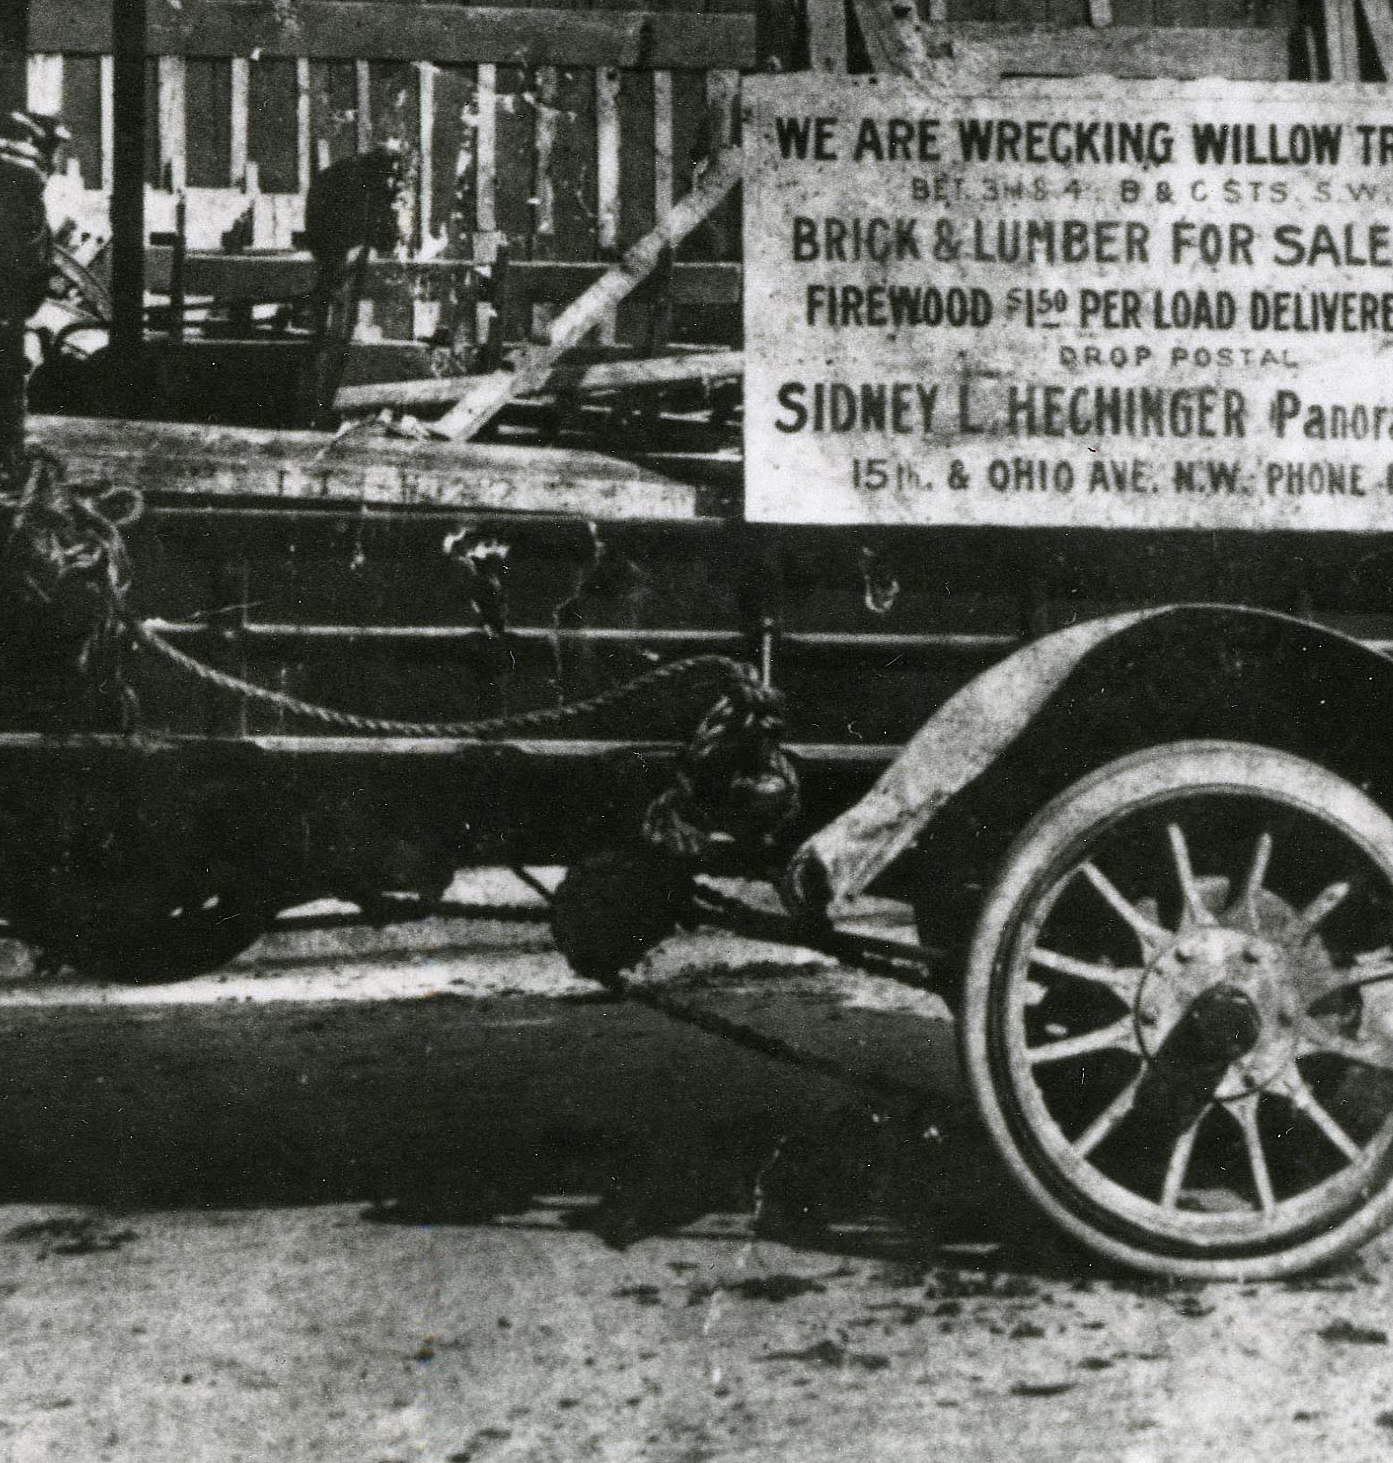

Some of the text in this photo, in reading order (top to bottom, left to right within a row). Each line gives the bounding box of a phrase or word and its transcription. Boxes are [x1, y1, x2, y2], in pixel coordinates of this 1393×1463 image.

[775, 116, 839, 162] WE
[853, 116, 942, 162] ARE
[956, 118, 1175, 165] WRECKING
[1192, 123, 1343, 166] WILLOW
[1120, 178, 1142, 203] B
[1156, 180, 1175, 204] &
[1190, 179, 1208, 202] C
[793, 216, 920, 263] BRICK
[933, 218, 961, 263] &
[974, 218, 1150, 265] LUMBER
[1172, 219, 1254, 266] FOR
[1272, 223, 1393, 268] SALE
[806, 284, 993, 328] FIREWOOD
[1080, 288, 1142, 329] PER
[1154, 289, 1236, 331] LOAD
[1059, 345, 1300, 370] DROP POSTAL
[774, 381, 939, 434] SIDNEY
[1008, 385, 1247, 439] HECHINGER
[947, 458, 971, 491] &
[987, 456, 1075, 494] OHIO
[1088, 459, 1160, 494] AVE.
[1172, 459, 1250, 495] N.W.
[1265, 461, 1366, 497] PHONE
